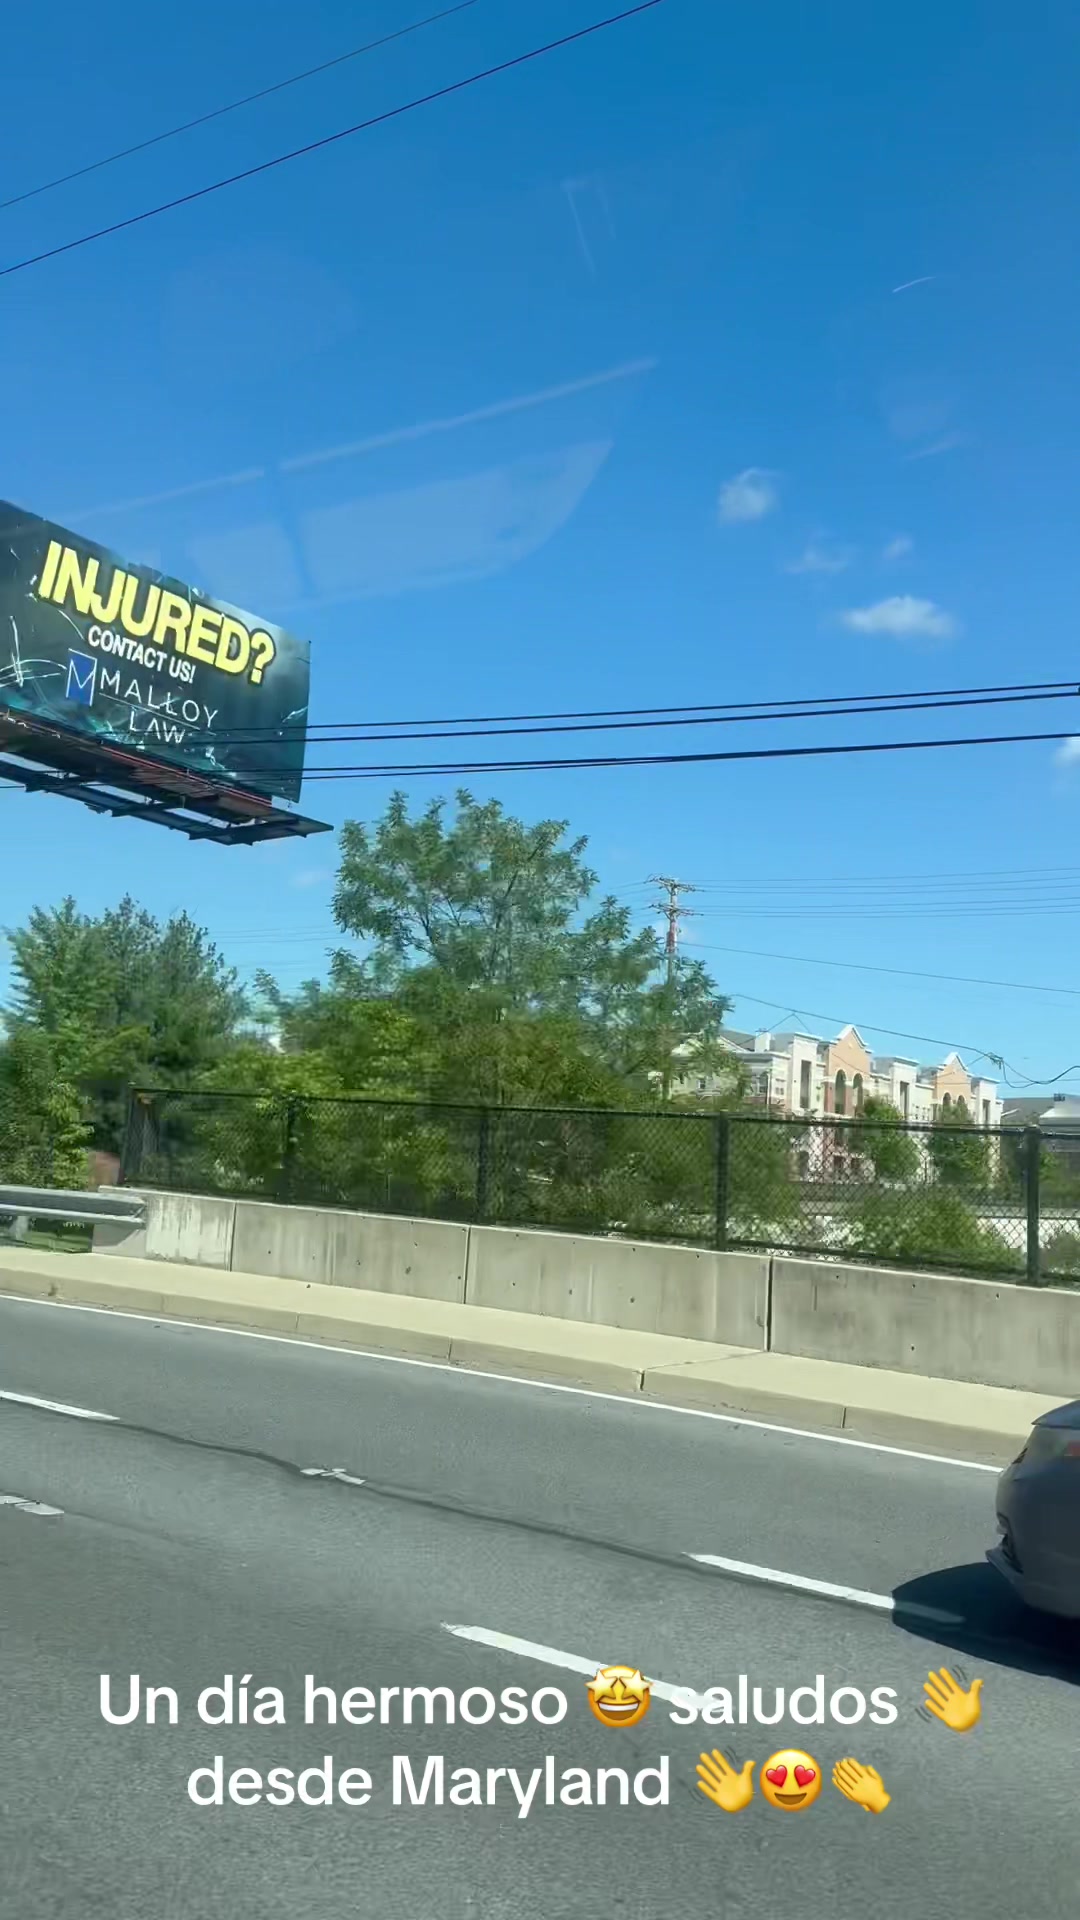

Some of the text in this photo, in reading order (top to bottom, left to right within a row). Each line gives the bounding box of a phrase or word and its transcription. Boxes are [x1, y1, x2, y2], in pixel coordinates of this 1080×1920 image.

[38, 540, 275, 686] INJURED?
[88, 625, 197, 684] CONTACT US!
[100, 667, 219, 729] MALLOY
[129, 710, 186, 744] LAW
